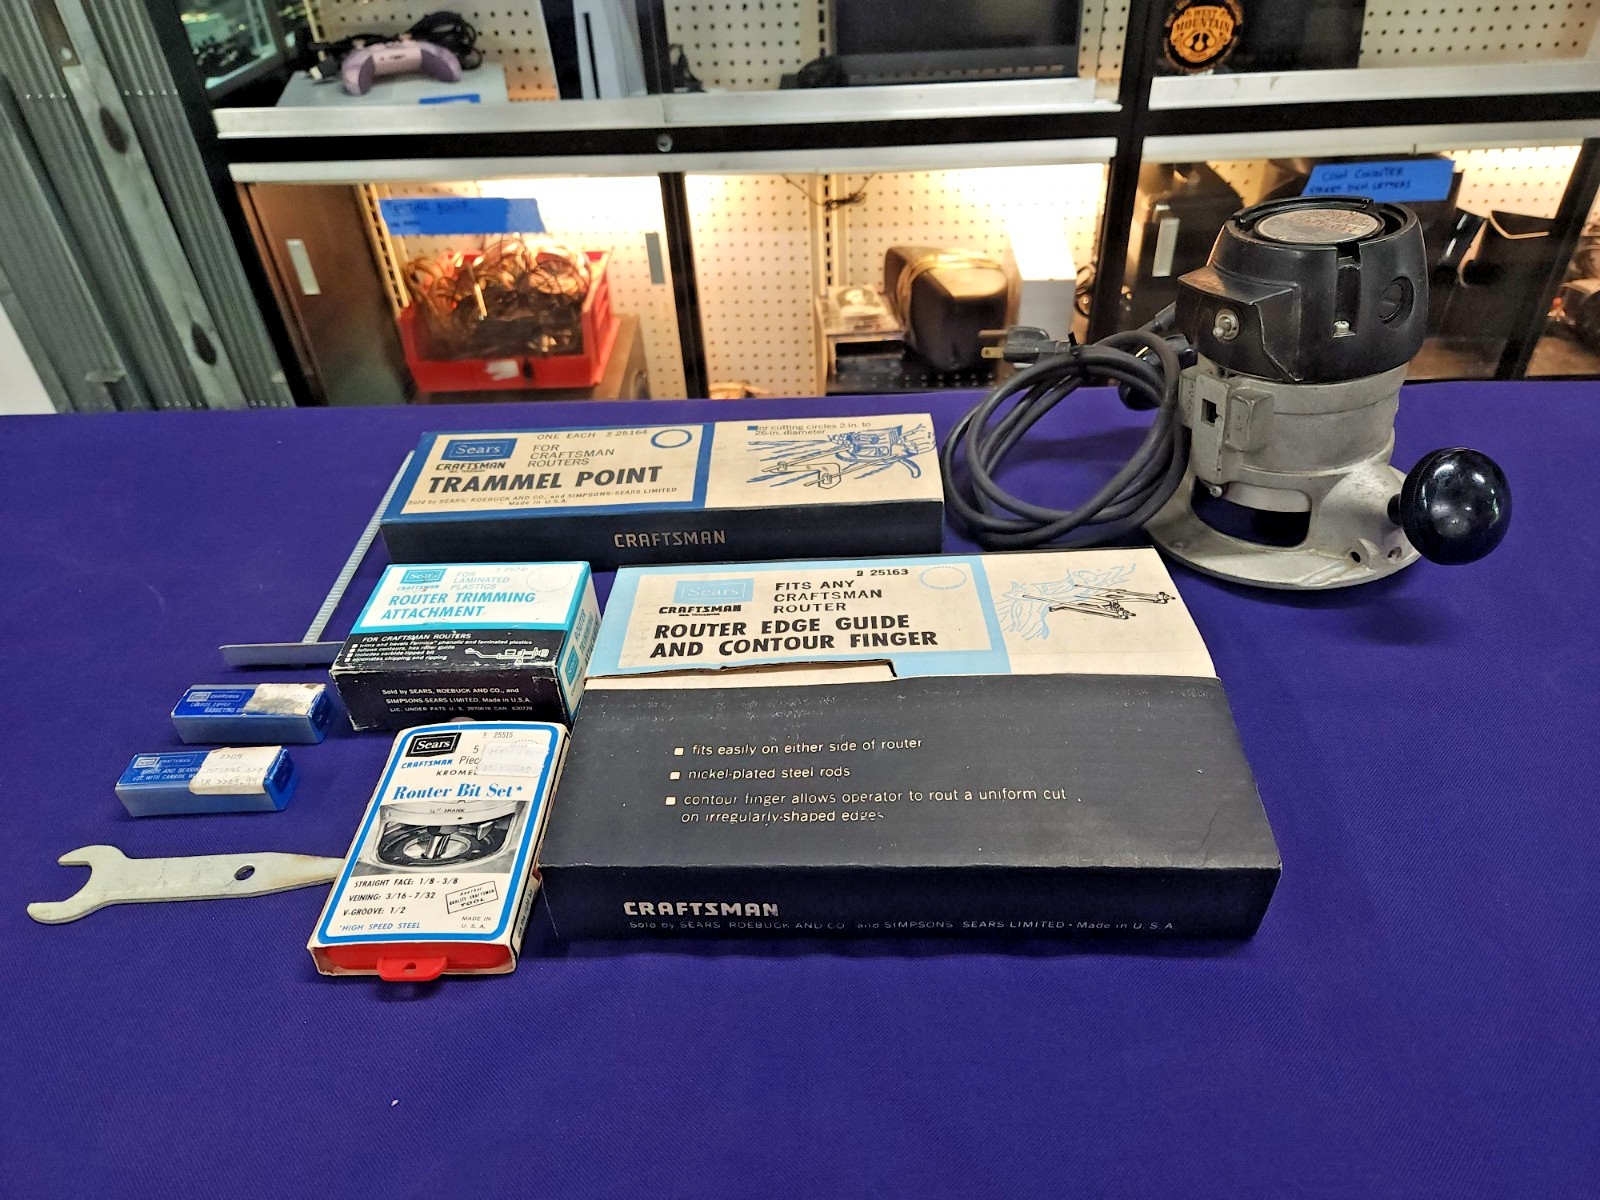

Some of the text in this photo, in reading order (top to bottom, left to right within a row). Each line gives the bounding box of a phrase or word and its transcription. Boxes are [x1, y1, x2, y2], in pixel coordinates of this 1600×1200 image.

[770, 424, 804, 432] cutting
[566, 432, 596, 440] EACH
[615, 429, 648, 437] 25164
[455, 444, 501, 455] Sears
[529, 448, 615, 459] CRAFTSMAN
[532, 444, 560, 452] FOR
[435, 461, 506, 471] CRAFTSMAN
[527, 458, 590, 468] ROUTERS
[428, 465, 663, 494] TRAMMEL POINT
[613, 530, 727, 548] CRAFTSMAN
[408, 571, 438, 580] Sears
[870, 568, 909, 577] 25163
[450, 583, 497, 591] PLASTICS
[775, 579, 856, 591] FITS ANY
[687, 585, 740, 597] Sears
[773, 589, 883, 602] CRAFTSMAN
[388, 592, 537, 606] ROUTER TRIMMING
[381, 605, 486, 620] ATTACHMENT
[658, 604, 742, 614] CRAFTSMAN
[773, 602, 847, 614] ROUTER
[654, 614, 911, 639] ROUTER EDGE GUIDE
[650, 631, 939, 659] AND CONTOUR FINGER
[493, 731, 513, 739] 25515
[416, 739, 451, 750] Sears
[473, 745, 479, 754] 5
[692, 738, 923, 757] fits easily on either side of router
[401, 759, 453, 769] CRAFTSMAN
[459, 755, 481, 765] Piec
[688, 766, 851, 781] nickel-plated steel rods
[392, 785, 453, 801] Router
[456, 782, 481, 797] Bit
[683, 787, 1067, 807] contour finger allows operator to rout a uniform cut
[681, 813, 699, 823] on
[705, 810, 836, 825] irregularly-shaped
[354, 877, 459, 888] STRAIGHT FACE: 1/8 3/8
[349, 891, 437, 902] VEINING: 3/16 7/32
[460, 897, 486, 908] TOOL
[342, 906, 407, 917] V-GROOVE: 1/2
[623, 901, 780, 917] CRAFTSMAN
[368, 922, 421, 930] SPEED STEEL
[629, 921, 657, 929] Sold
[661, 921, 675, 930] by
[680, 921, 721, 929] SEARS
[729, 921, 791, 930] ROEBUCK
[795, 921, 823, 929] AND
[857, 921, 880, 929] and
[1009, 920, 1065, 929] LIMITED
[1076, 920, 1112, 930] Made
[1115, 921, 1128, 929] in
